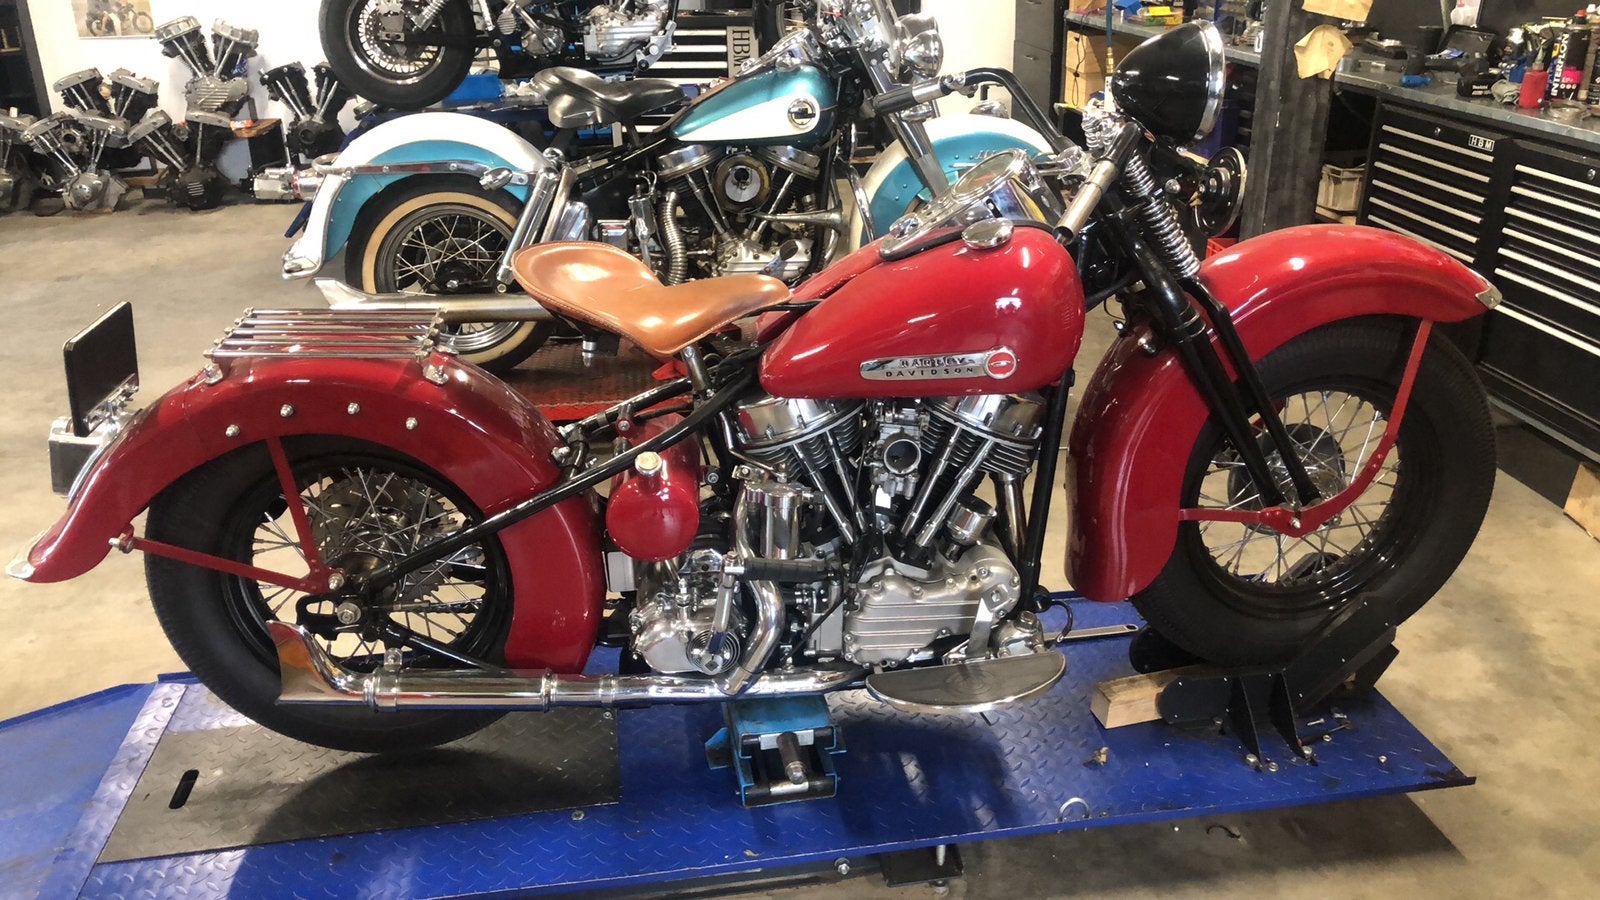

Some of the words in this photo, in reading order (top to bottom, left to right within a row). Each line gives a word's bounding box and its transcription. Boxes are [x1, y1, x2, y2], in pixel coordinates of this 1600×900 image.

[732, 29, 751, 68] HBM
[1550, 33, 1570, 97] INTERFLON
[1471, 136, 1491, 149] HBM
[886, 368, 973, 377] DAVIDSON
